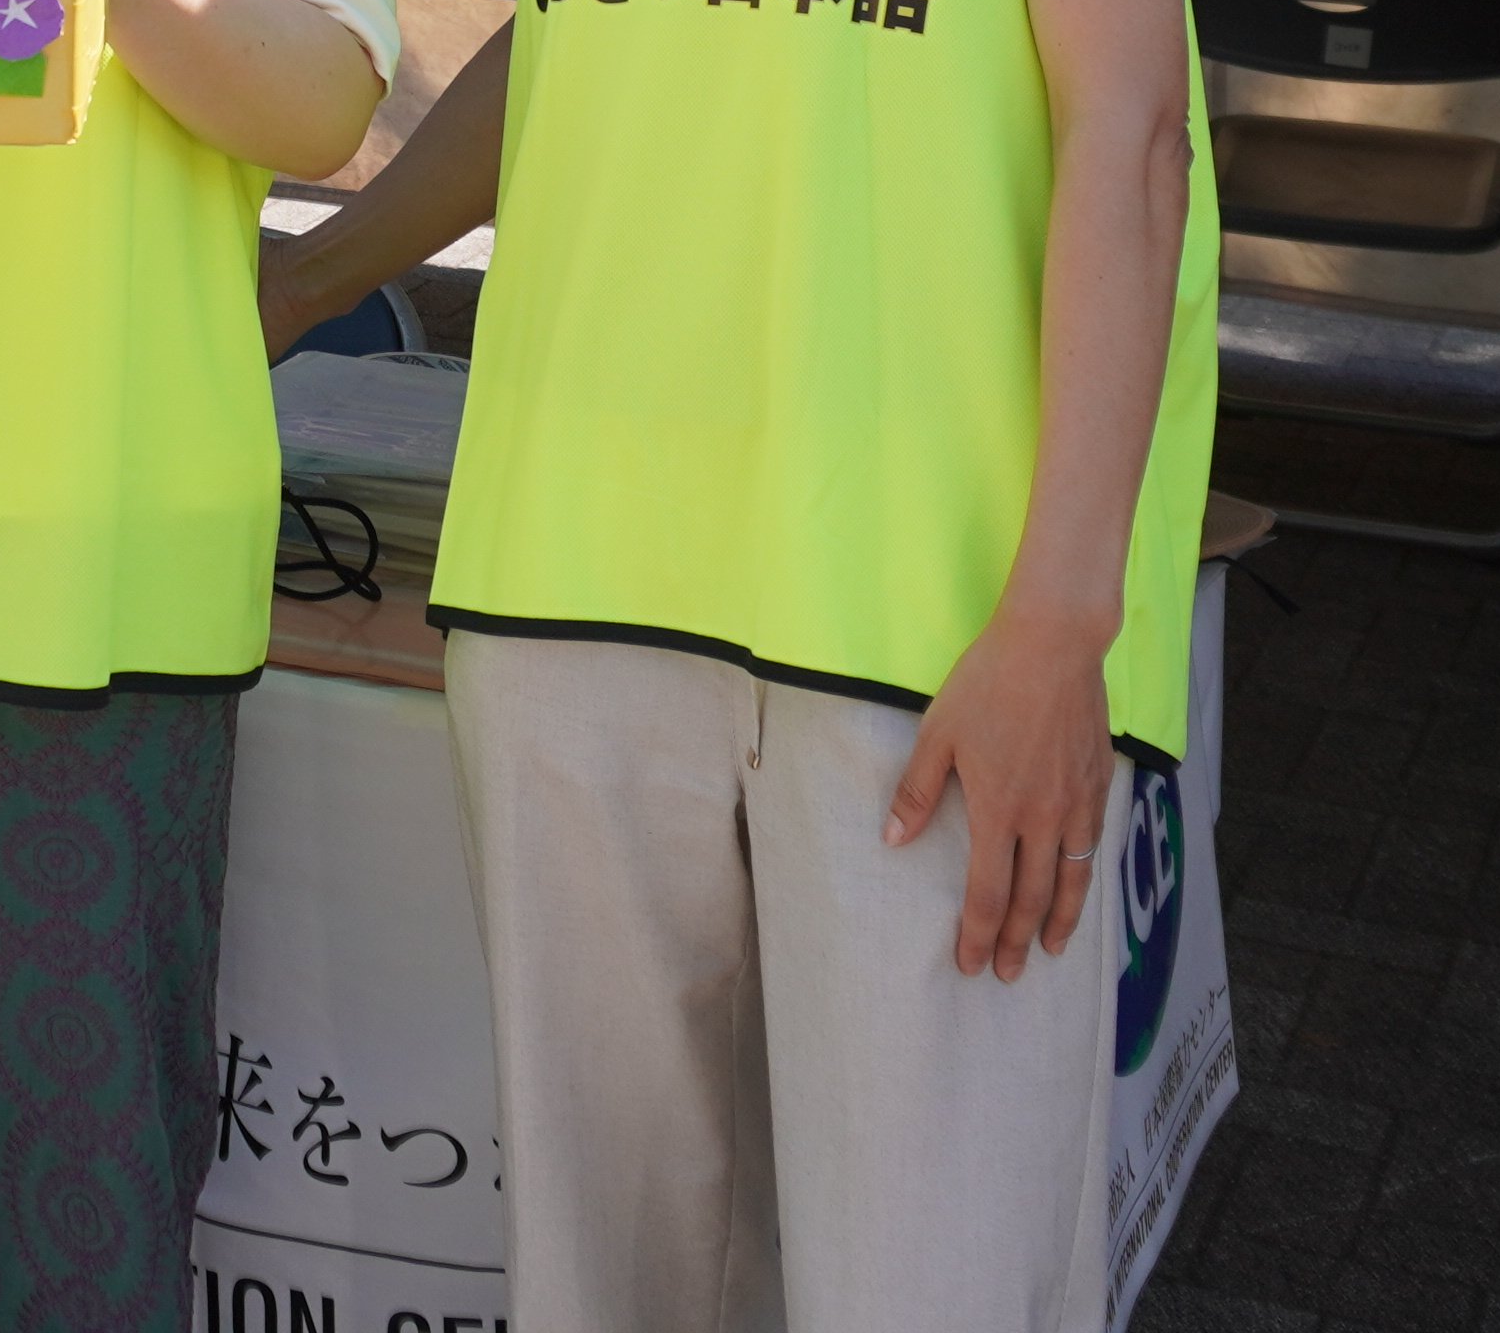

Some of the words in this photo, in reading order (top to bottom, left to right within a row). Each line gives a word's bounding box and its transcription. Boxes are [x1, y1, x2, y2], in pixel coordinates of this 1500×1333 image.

[1116, 1181, 1166, 1305] INTERNATIONAL
[1165, 1096, 1205, 1193] COOPERATION
[1203, 1038, 1235, 1108] CENTER
